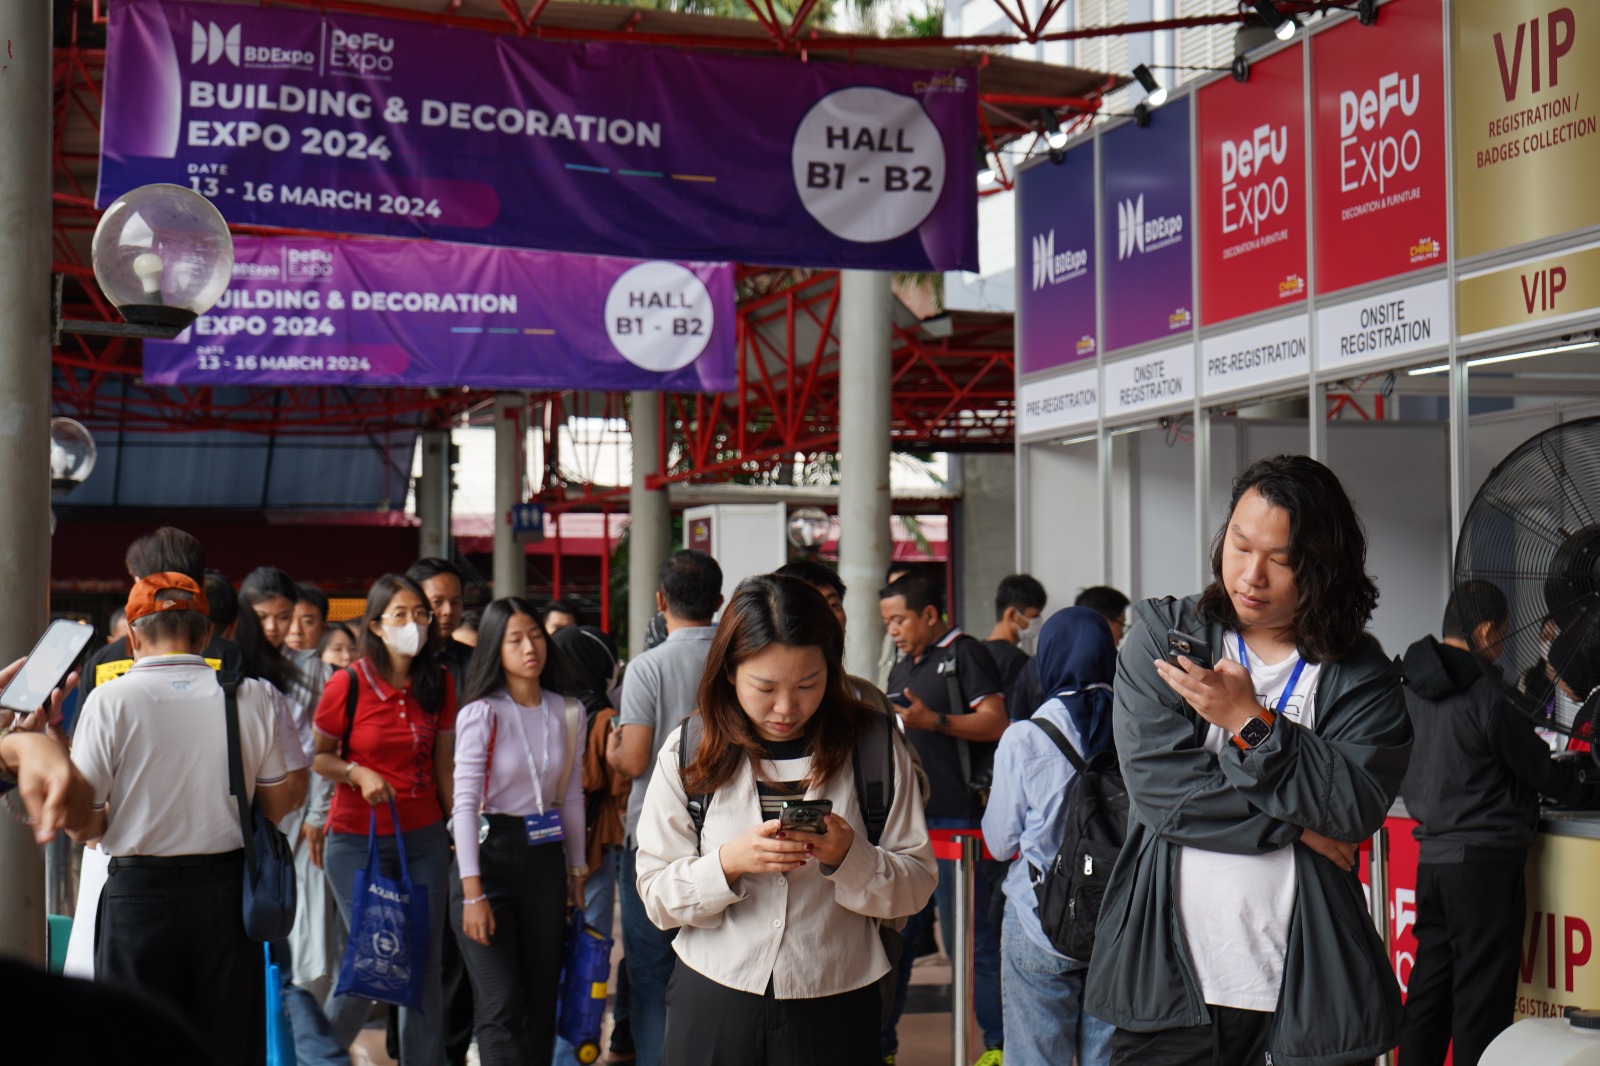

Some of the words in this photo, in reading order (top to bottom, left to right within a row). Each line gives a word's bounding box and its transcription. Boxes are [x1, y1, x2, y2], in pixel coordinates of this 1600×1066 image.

[245, 46, 315, 65] BDExpo
[332, 29, 394, 53] DeFu
[1493, 7, 1576, 102] VIP
[330, 46, 394, 74] Expo
[188, 80, 372, 119] BUILDING
[382, 96, 409, 123] &
[421, 99, 661, 148] DECORATION
[1340, 71, 1420, 139] DeFu
[1489, 95, 1571, 139] REGISTRATION
[187, 120, 290, 151] EXPO
[300, 127, 391, 161] 2024
[826, 126, 915, 154] HALL
[1222, 123, 1287, 184] DeFu
[1476, 140, 1520, 169] BADGES
[1523, 115, 1597, 155] COLLECTION
[187, 162, 229, 176] DATE
[807, 161, 845, 190] B1
[884, 165, 933, 192] B2
[1341, 128, 1421, 195] Expo
[188, 176, 219, 197] 13
[242, 181, 274, 203] 16
[280, 186, 372, 211] MARCH
[379, 195, 442, 218] 2024
[1222, 176, 1289, 235] Expo
[216, 289, 320, 310] UILDING
[326, 290, 345, 310] &
[352, 291, 517, 314] DECORATION
[628, 291, 694, 309] HALL
[1521, 266, 1567, 314] VIP
[195, 315, 267, 336] EXPO
[272, 316, 336, 336] 2024
[617, 317, 643, 335] B1
[672, 317, 705, 336] B2
[1361, 299, 1405, 329] ONSITE
[1341, 318, 1431, 357] REGISTRATION
[198, 355, 220, 371] 13
[235, 355, 257, 371] 16
[260, 356, 323, 371] MARCH
[327, 356, 371, 372] 2024
[1134, 360, 1165, 383] ONSITE
[1208, 337, 1307, 377] PRE-REGISTRATION
[1026, 388, 1097, 417] PRE-REGISTRATION
[1120, 376, 1182, 406] REGISTRATION
